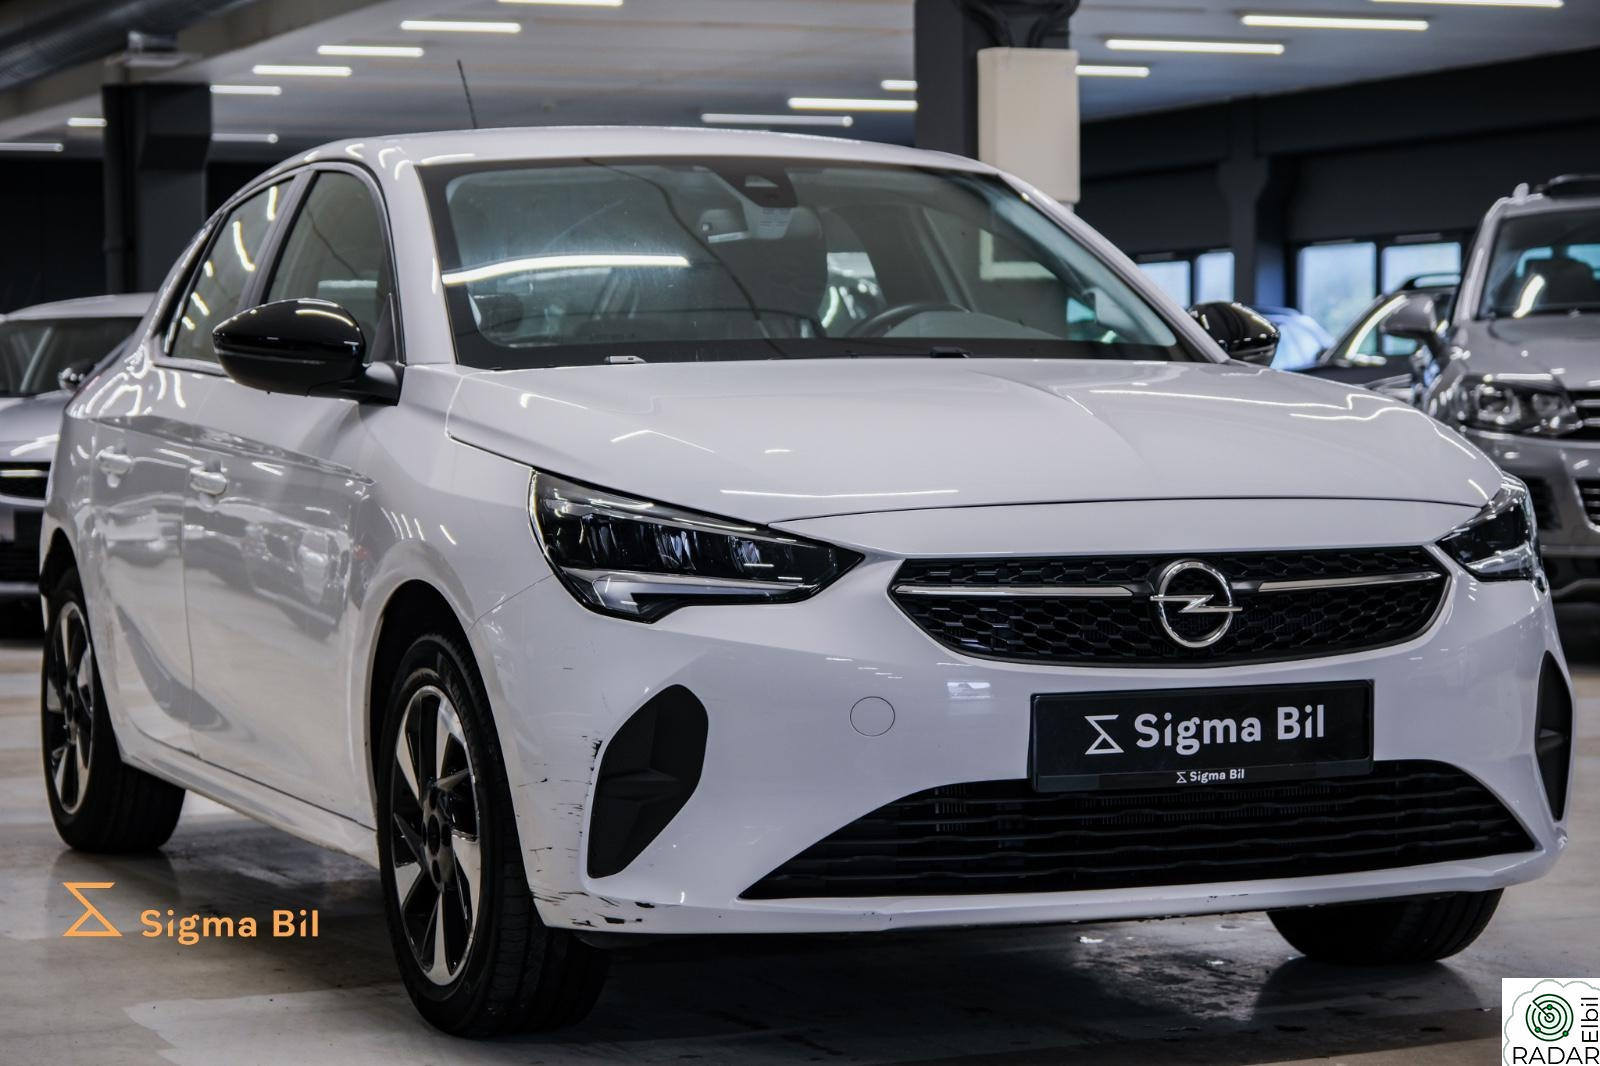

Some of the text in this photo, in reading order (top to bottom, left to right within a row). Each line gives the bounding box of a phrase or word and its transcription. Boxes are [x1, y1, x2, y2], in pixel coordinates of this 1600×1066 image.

[1134, 704, 1325, 756] Sigma Bil
[1189, 768, 1245, 783] Sigma Bil
